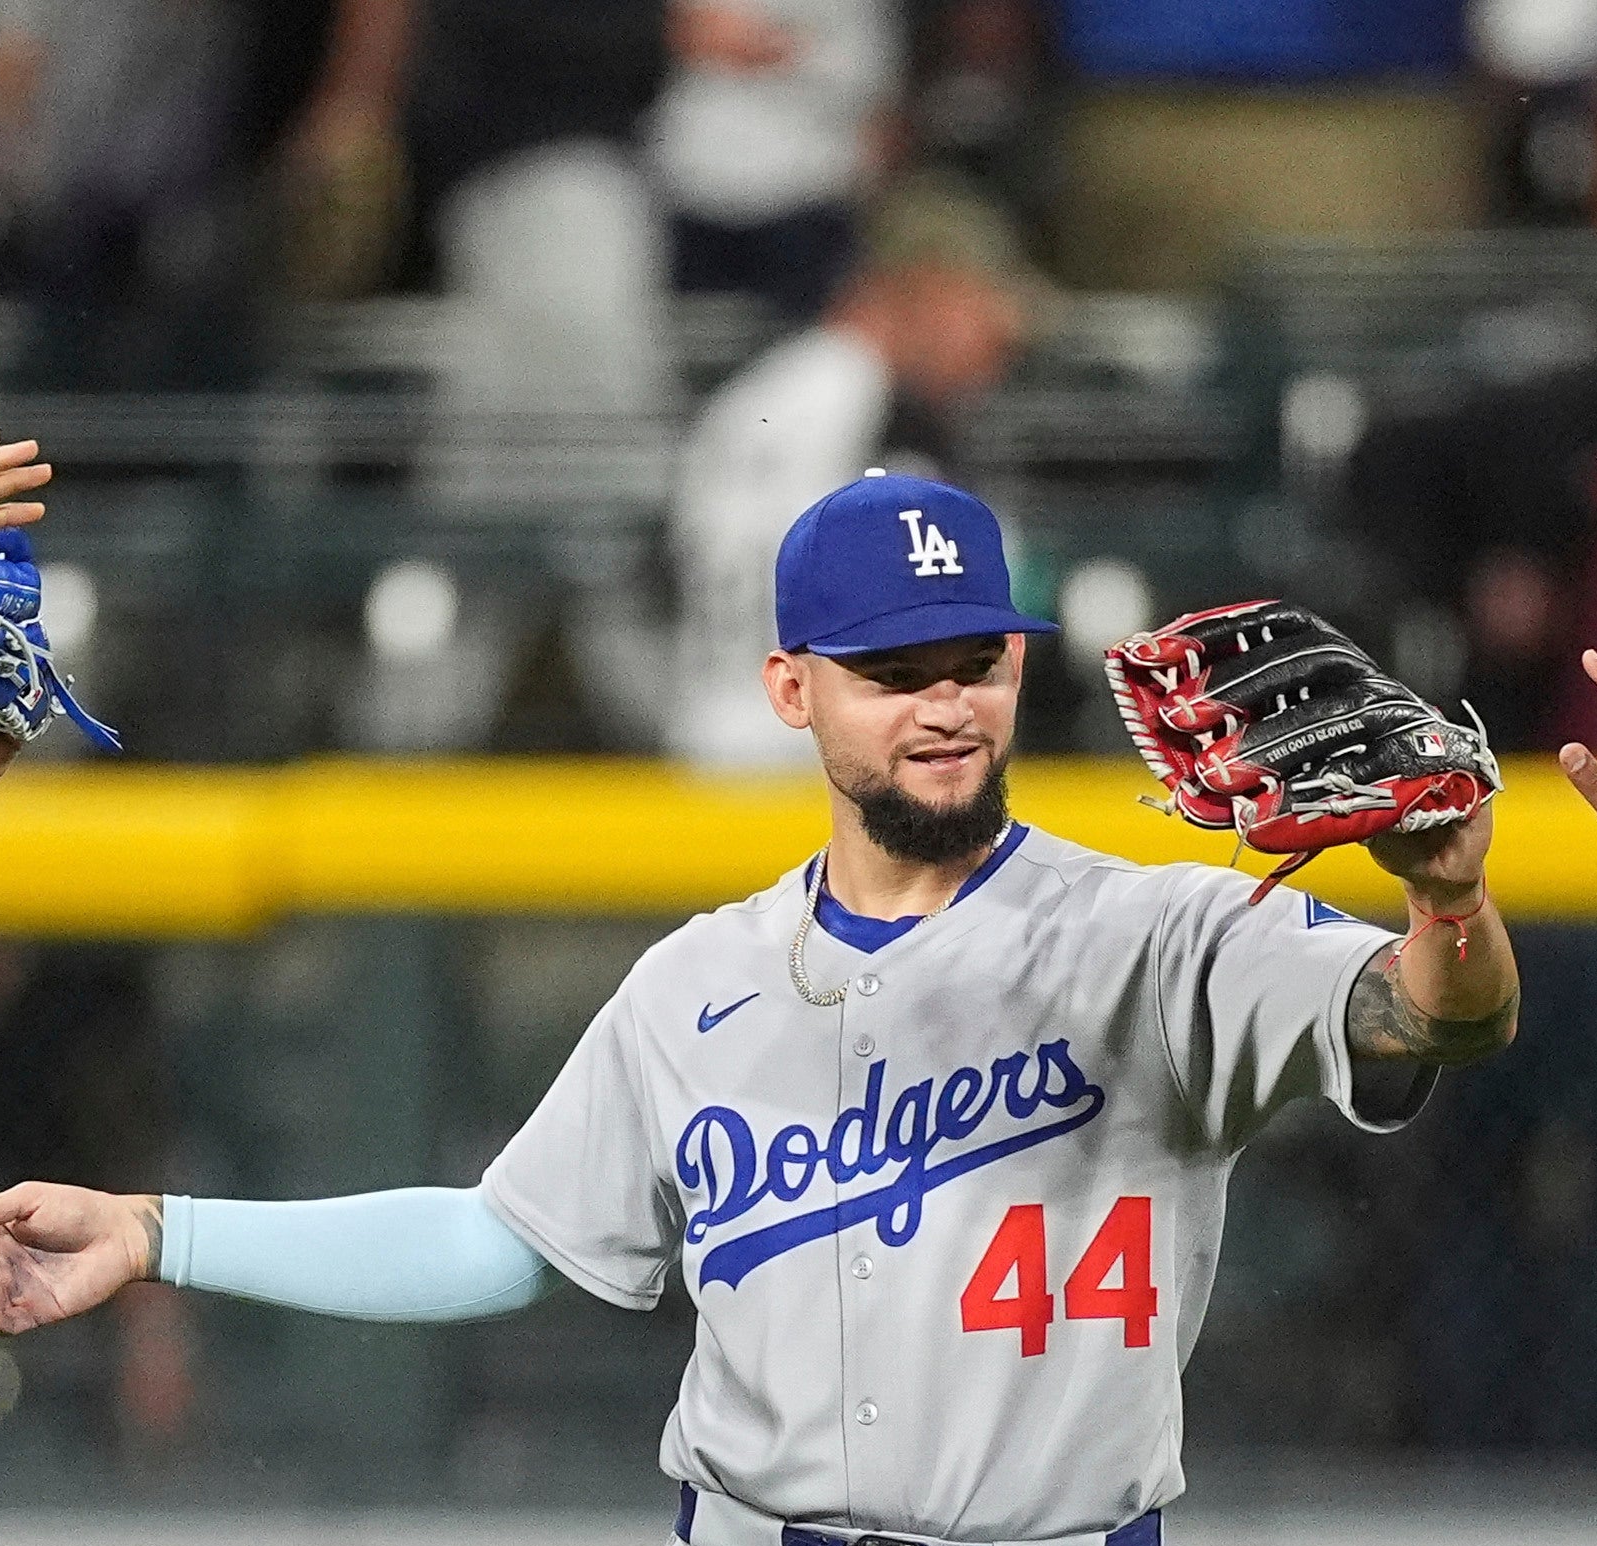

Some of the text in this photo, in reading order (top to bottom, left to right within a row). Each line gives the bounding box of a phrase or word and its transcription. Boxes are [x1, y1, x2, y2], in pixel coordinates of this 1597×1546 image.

[899, 510, 963, 576] LA
[1265, 742, 1290, 763] THE
[1287, 733, 1316, 752] GOLD
[1315, 721, 1350, 741] GLOVE
[676, 1038, 1104, 1250] Dodgers
[959, 1196, 1158, 1358] 44
